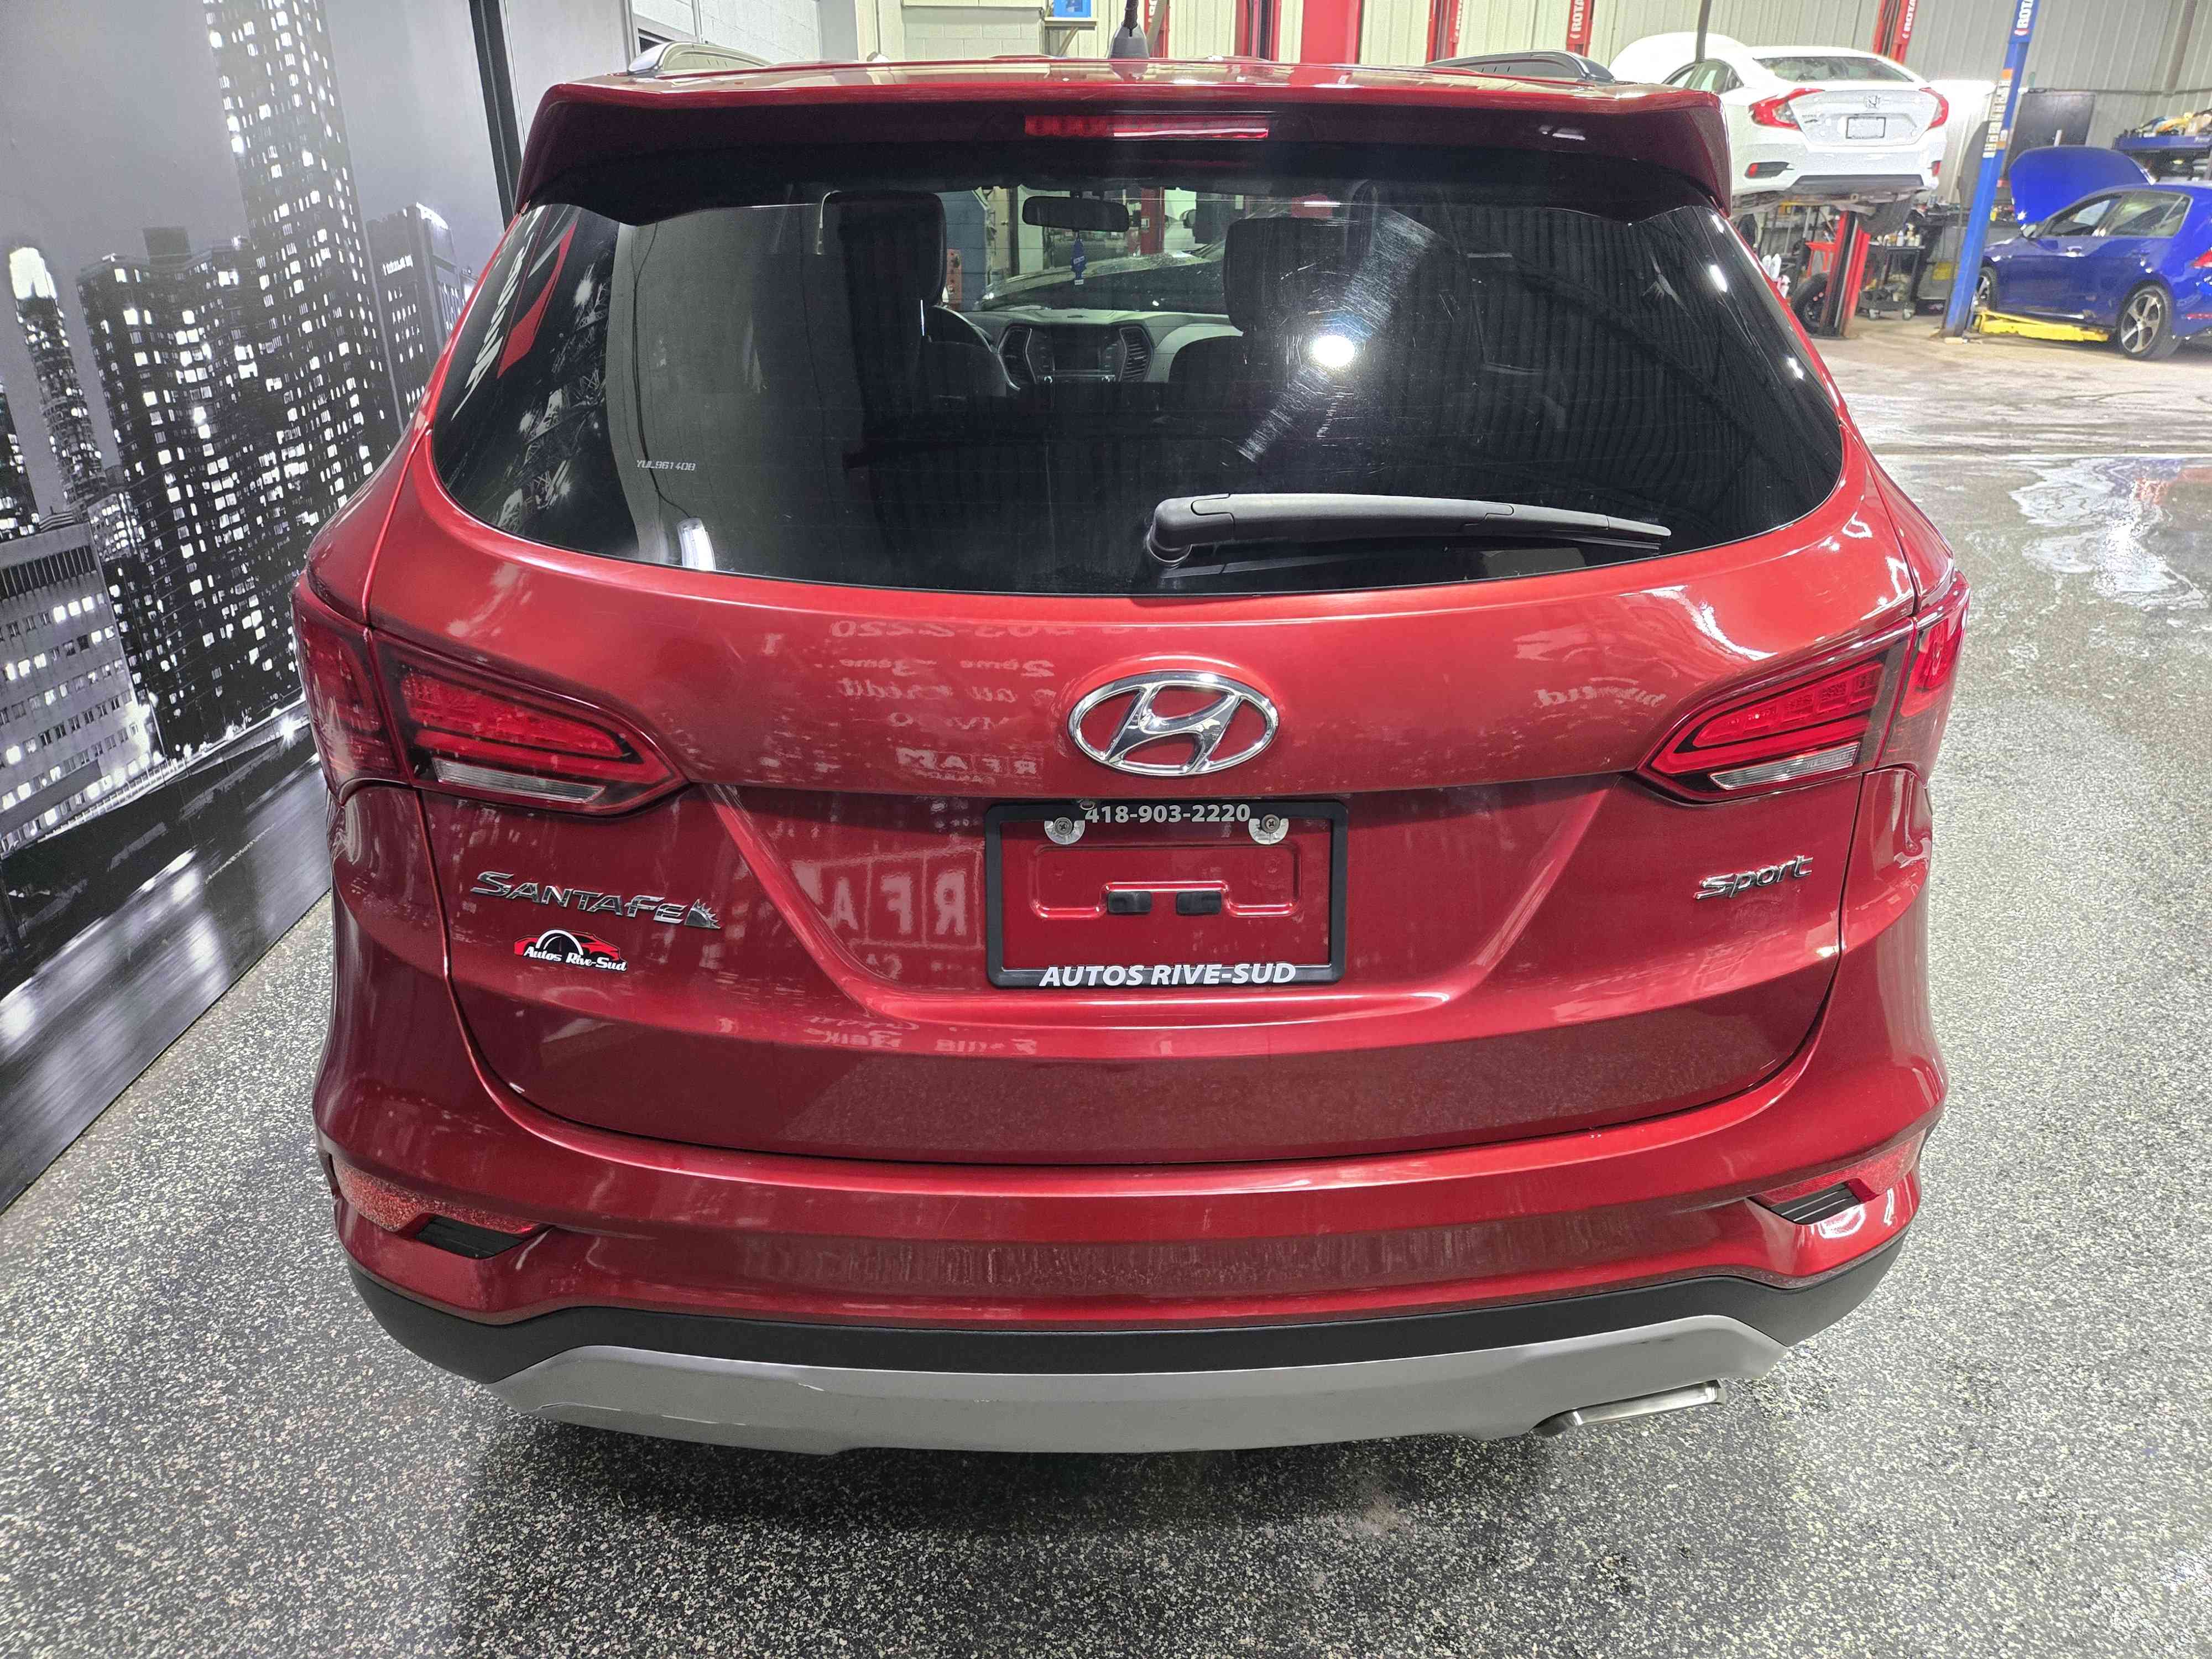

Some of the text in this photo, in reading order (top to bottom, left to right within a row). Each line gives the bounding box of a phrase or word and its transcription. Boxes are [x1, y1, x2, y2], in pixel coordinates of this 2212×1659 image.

[1085, 804, 1251, 823] 418-903-2220
[524, 946, 627, 972] Autos Rive-Sud
[1039, 963, 1296, 986] AUTOS RIVE-SUD
